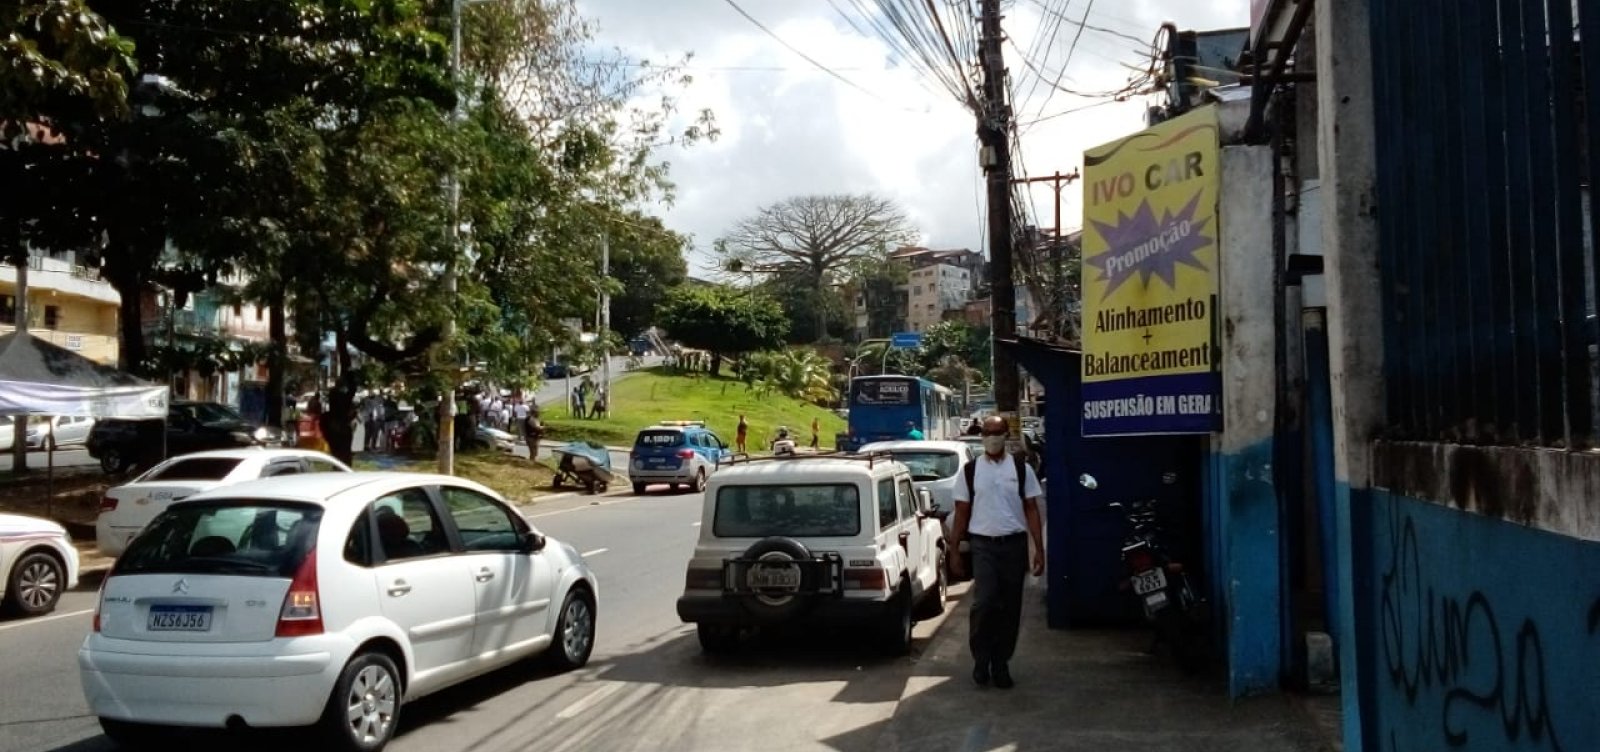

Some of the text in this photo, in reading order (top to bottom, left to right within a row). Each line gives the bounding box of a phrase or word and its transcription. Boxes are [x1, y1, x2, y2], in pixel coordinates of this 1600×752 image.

[1093, 151, 1204, 206] IVO CAR
[1105, 220, 1192, 277] Promoção
[1095, 297, 1205, 333] Alinhamento
[1084, 341, 1210, 377] Balanceament
[1084, 394, 1154, 419] SUSPENSÃO
[1156, 395, 1175, 415] EM
[153, 614, 204, 628] NZS6J56
